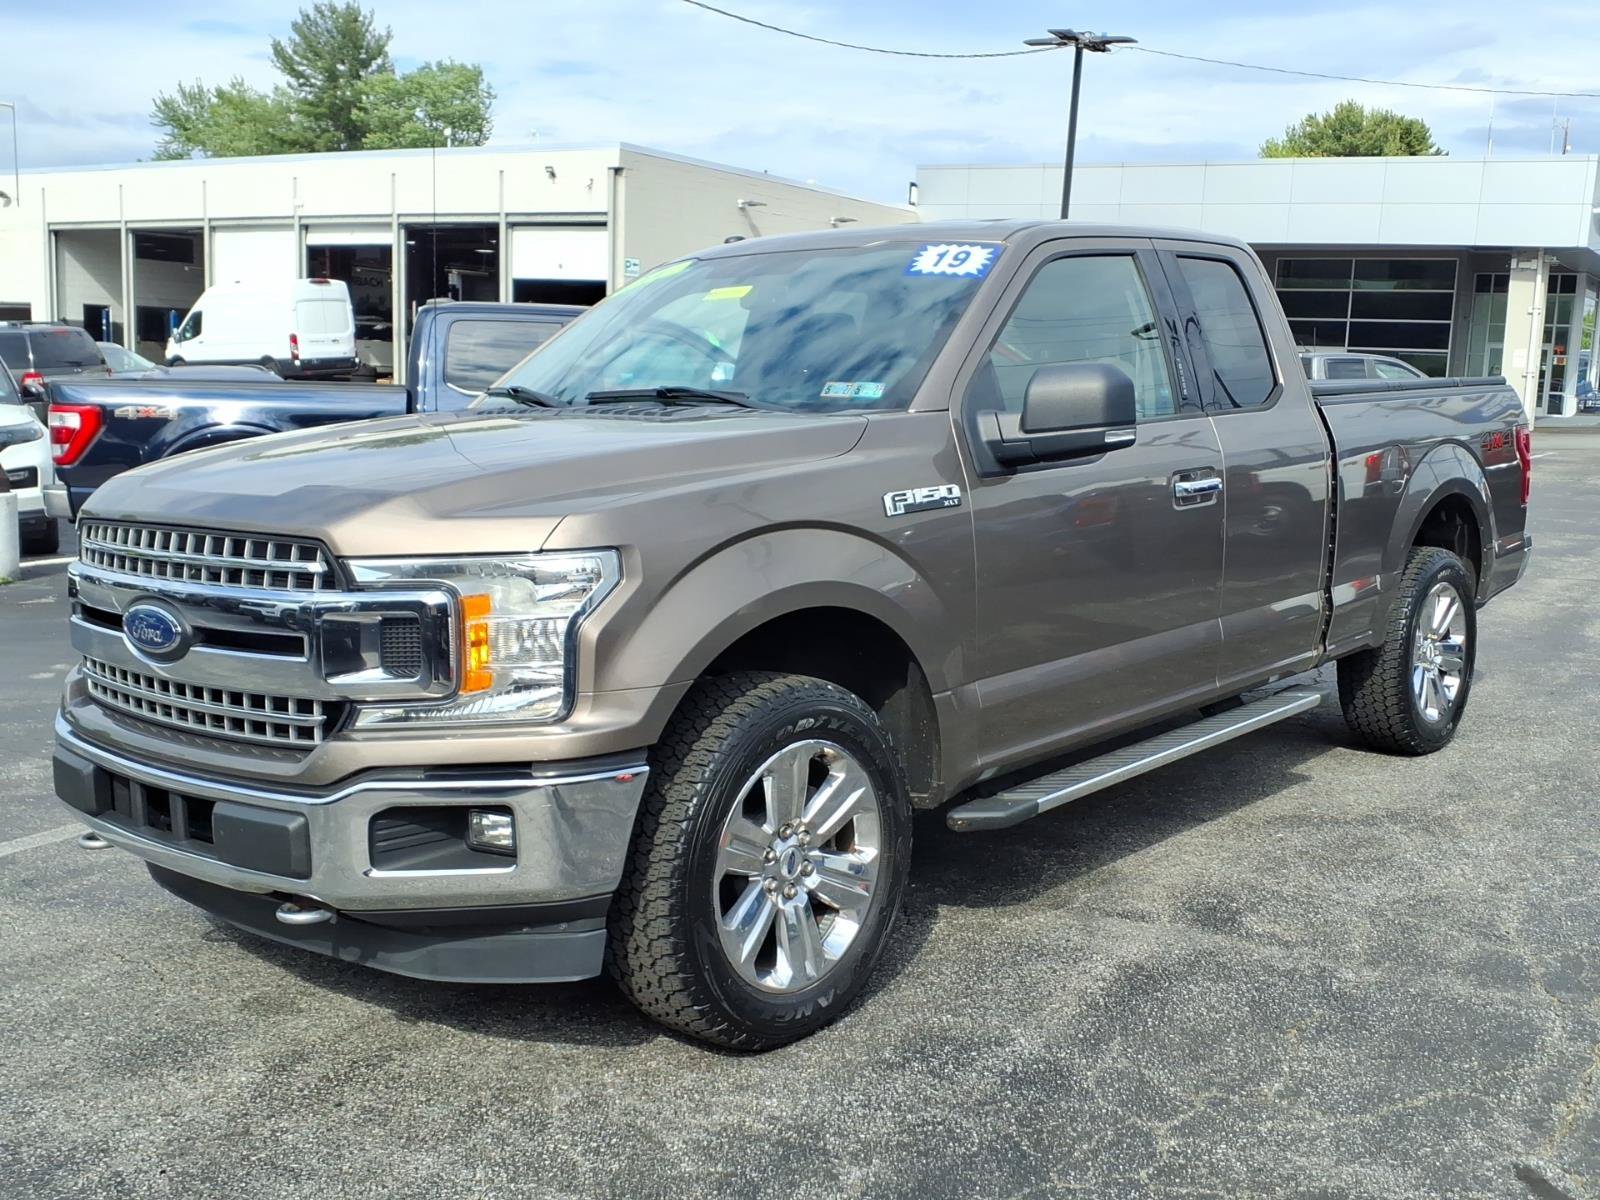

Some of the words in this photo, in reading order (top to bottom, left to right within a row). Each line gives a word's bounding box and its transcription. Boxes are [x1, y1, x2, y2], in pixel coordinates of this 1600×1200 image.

[932, 249, 971, 268] 19
[943, 498, 960, 507] XLT
[132, 614, 165, 643] Ford
